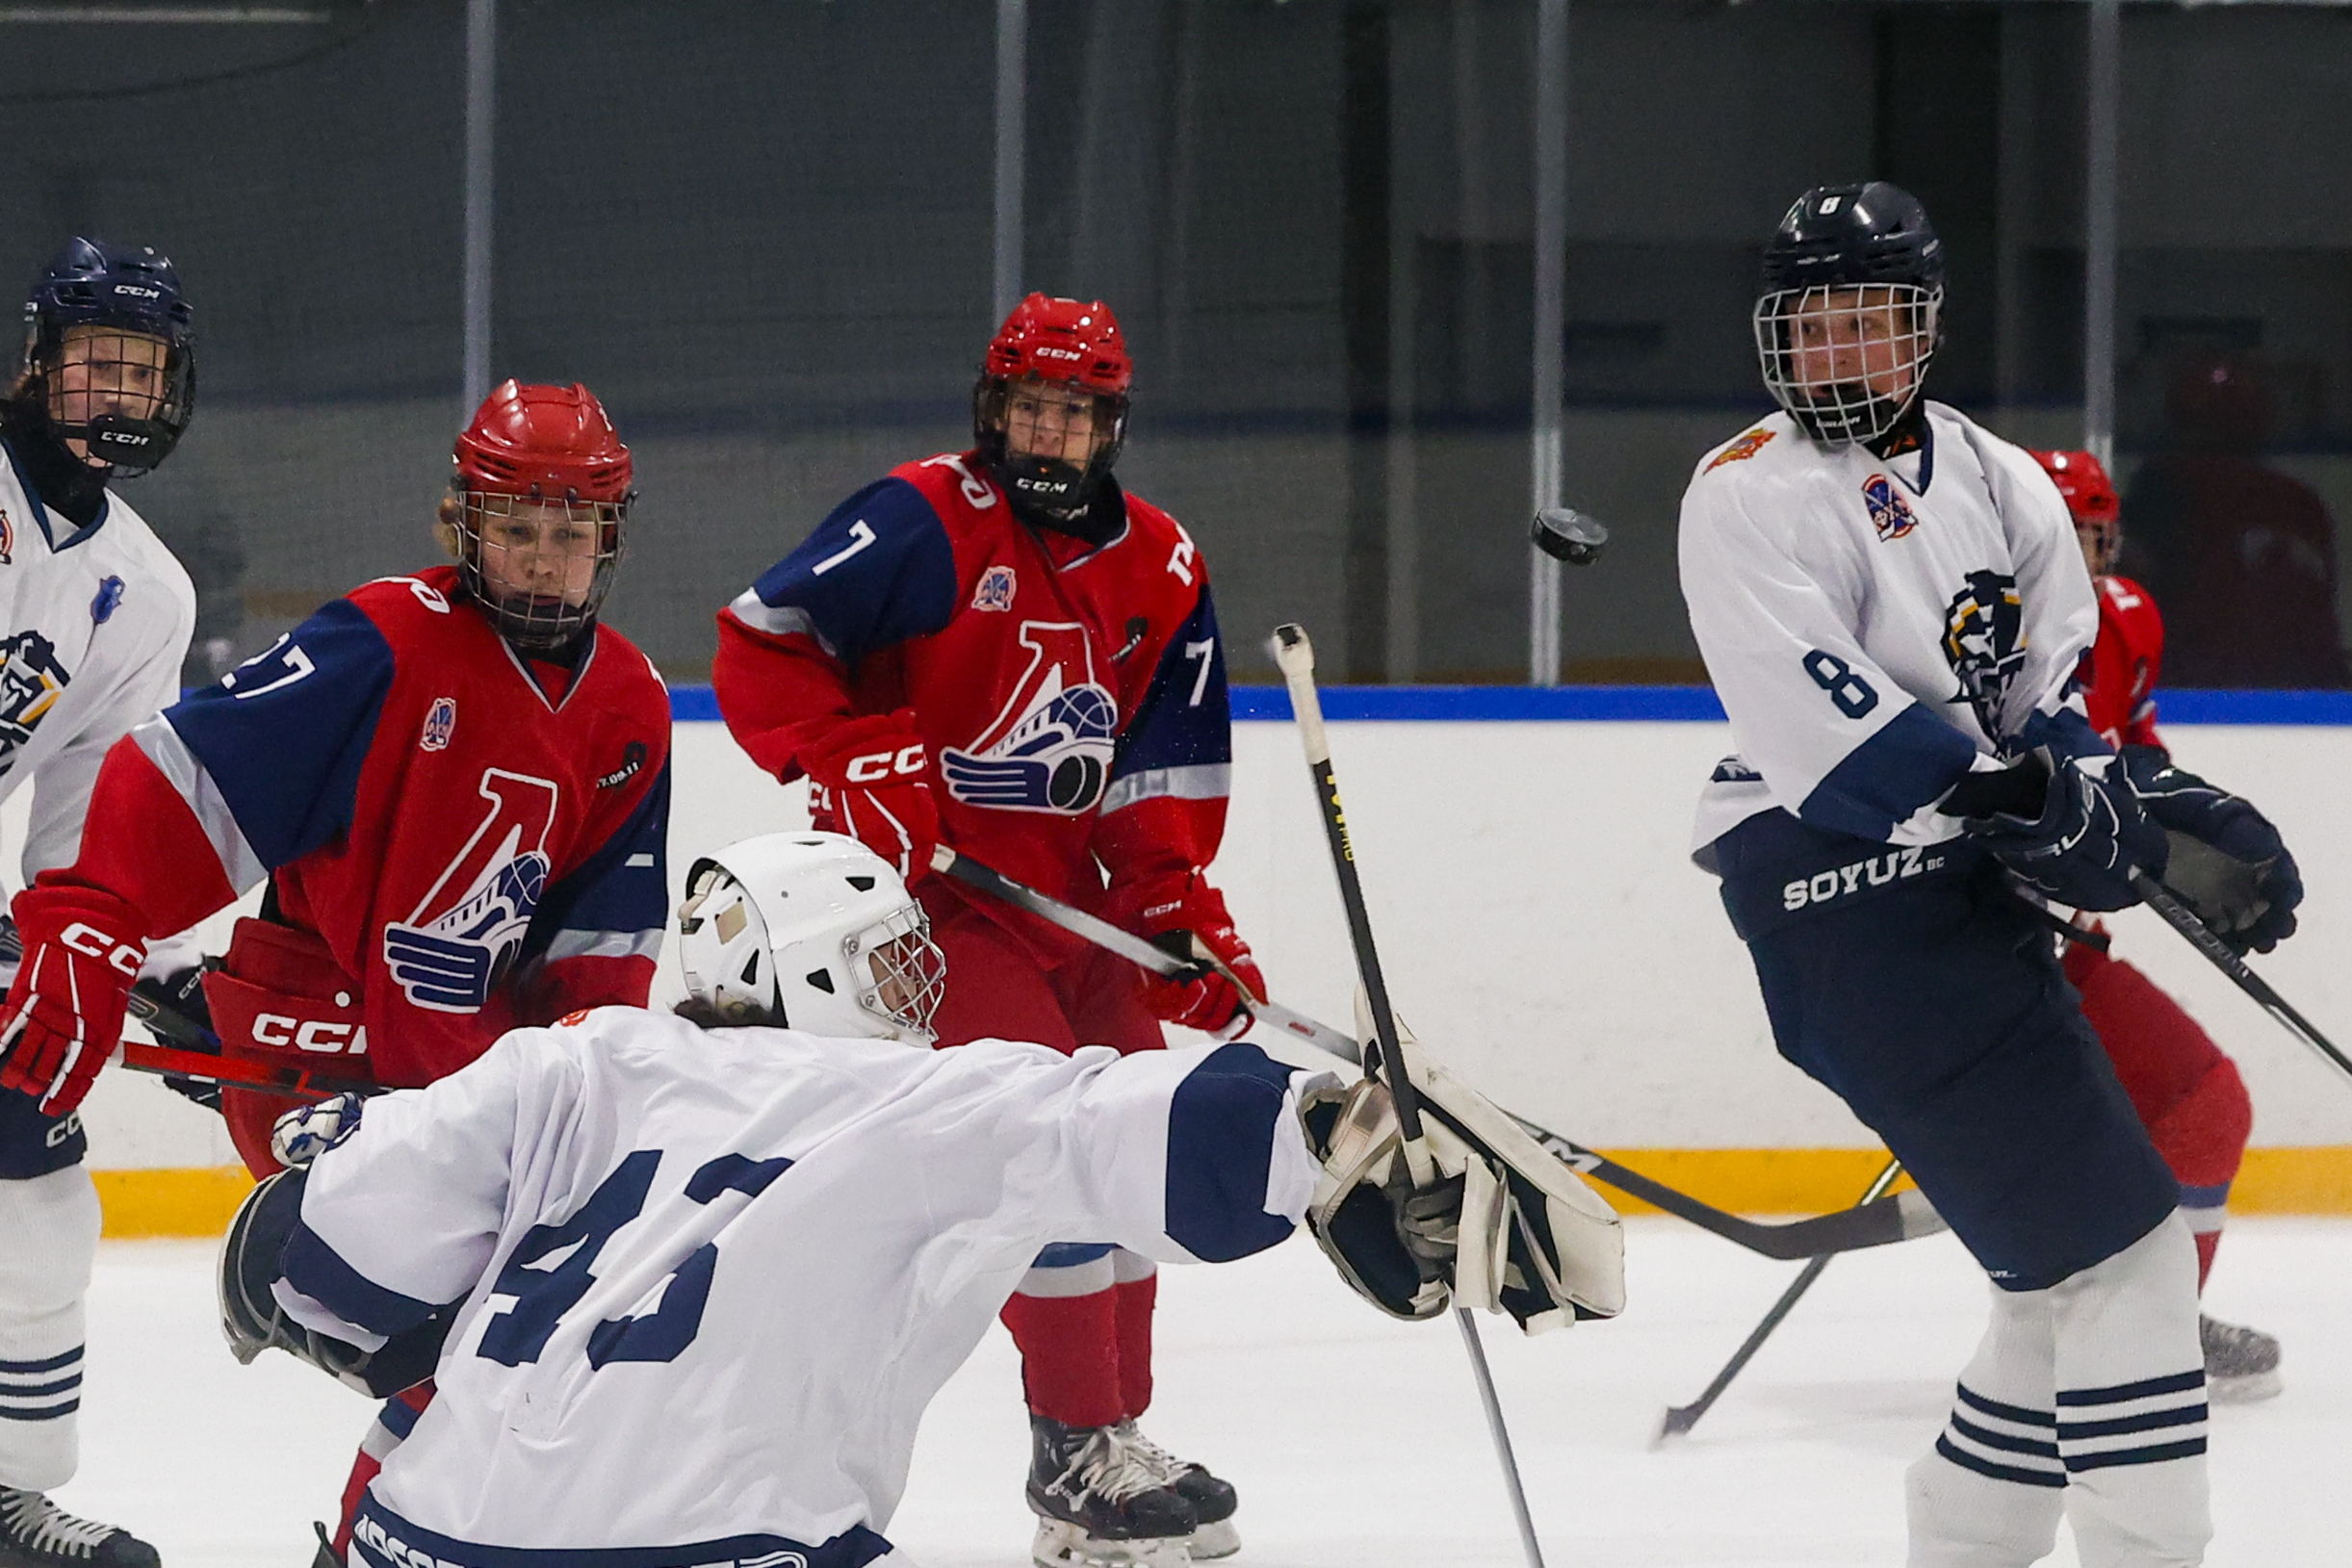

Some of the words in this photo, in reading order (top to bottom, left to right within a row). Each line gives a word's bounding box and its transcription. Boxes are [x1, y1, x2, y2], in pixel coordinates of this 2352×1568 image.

[1819, 195, 1842, 215] 8
[114, 285, 161, 298] CCM
[1036, 347, 1081, 361] CCM
[100, 431, 149, 446] CCM
[1017, 477, 1068, 494] CCM
[812, 519, 877, 576] 7
[1185, 636, 1214, 707] 7
[1802, 649, 1878, 719] 8
[1784, 846, 1924, 911] SOYUZ
[476, 1149, 796, 1373] 43
